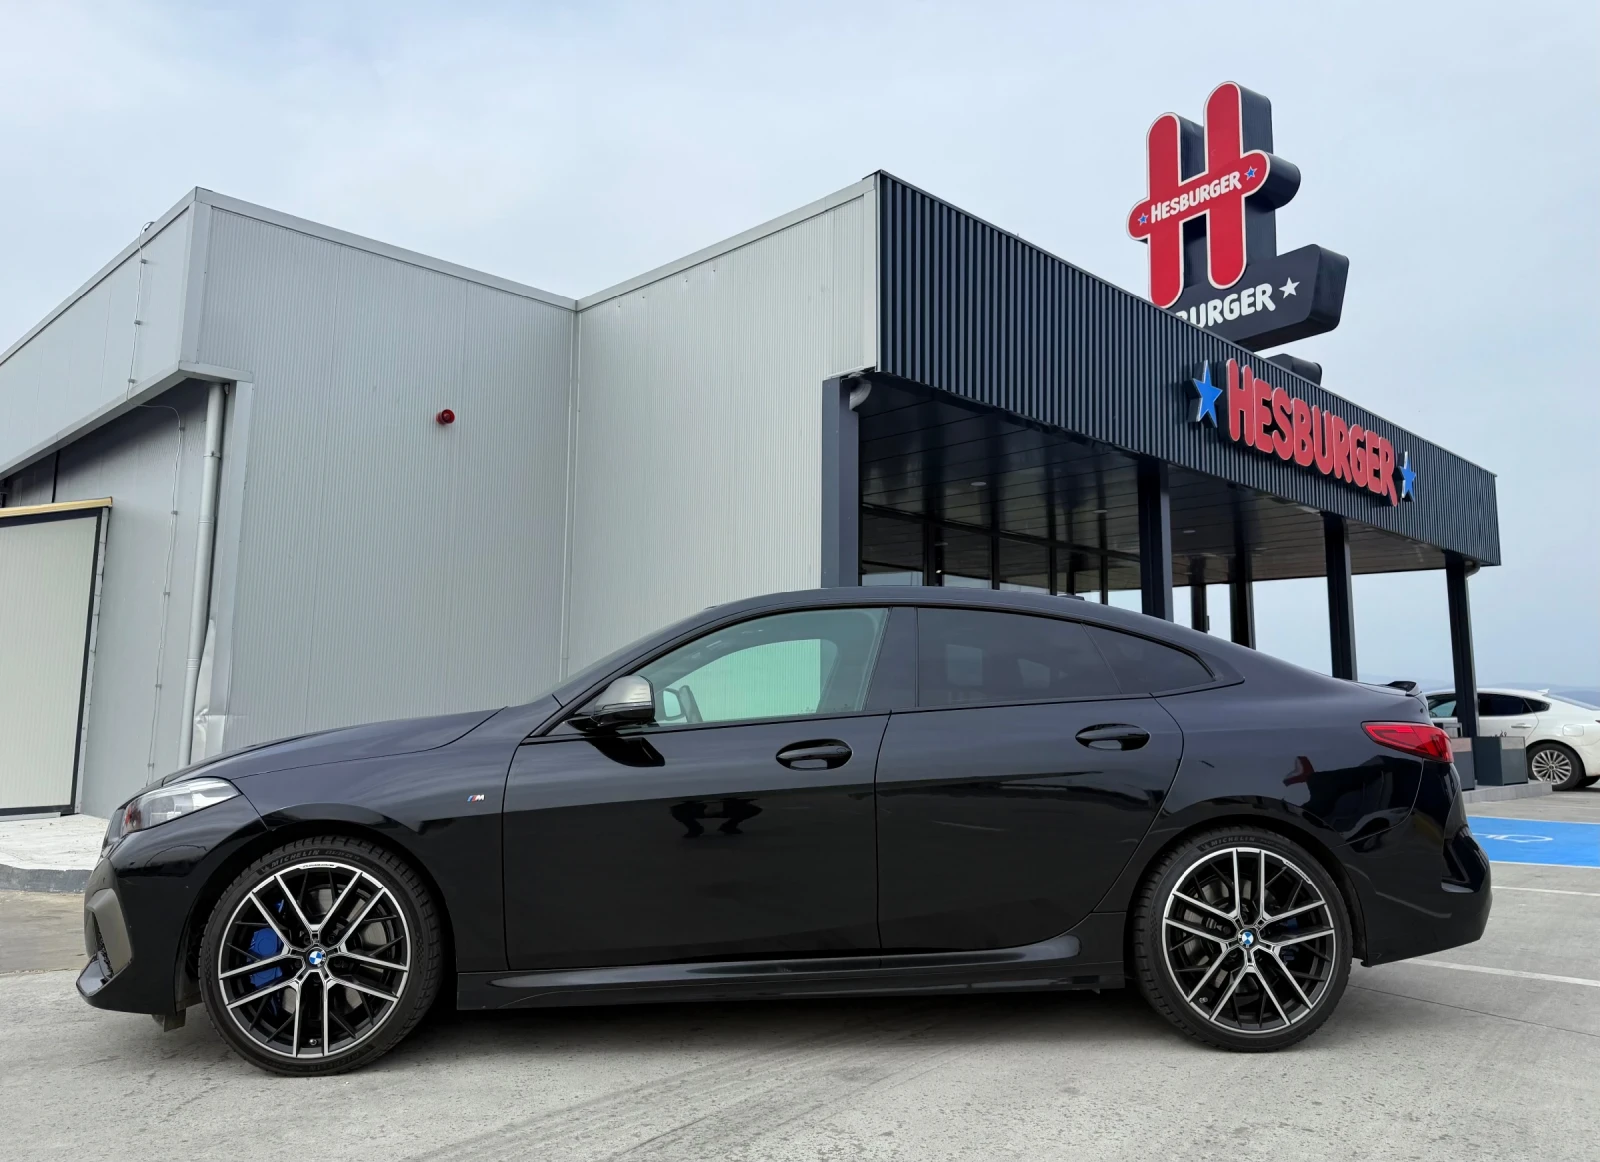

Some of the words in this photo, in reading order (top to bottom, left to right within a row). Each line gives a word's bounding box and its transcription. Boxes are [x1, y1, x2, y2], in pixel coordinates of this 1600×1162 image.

[1151, 171, 1242, 223] HESBURGER
[1225, 358, 1398, 507] HESBURGER
[271, 849, 320, 867] MICHELIN
[1211, 836, 1255, 846] MICHELIN
